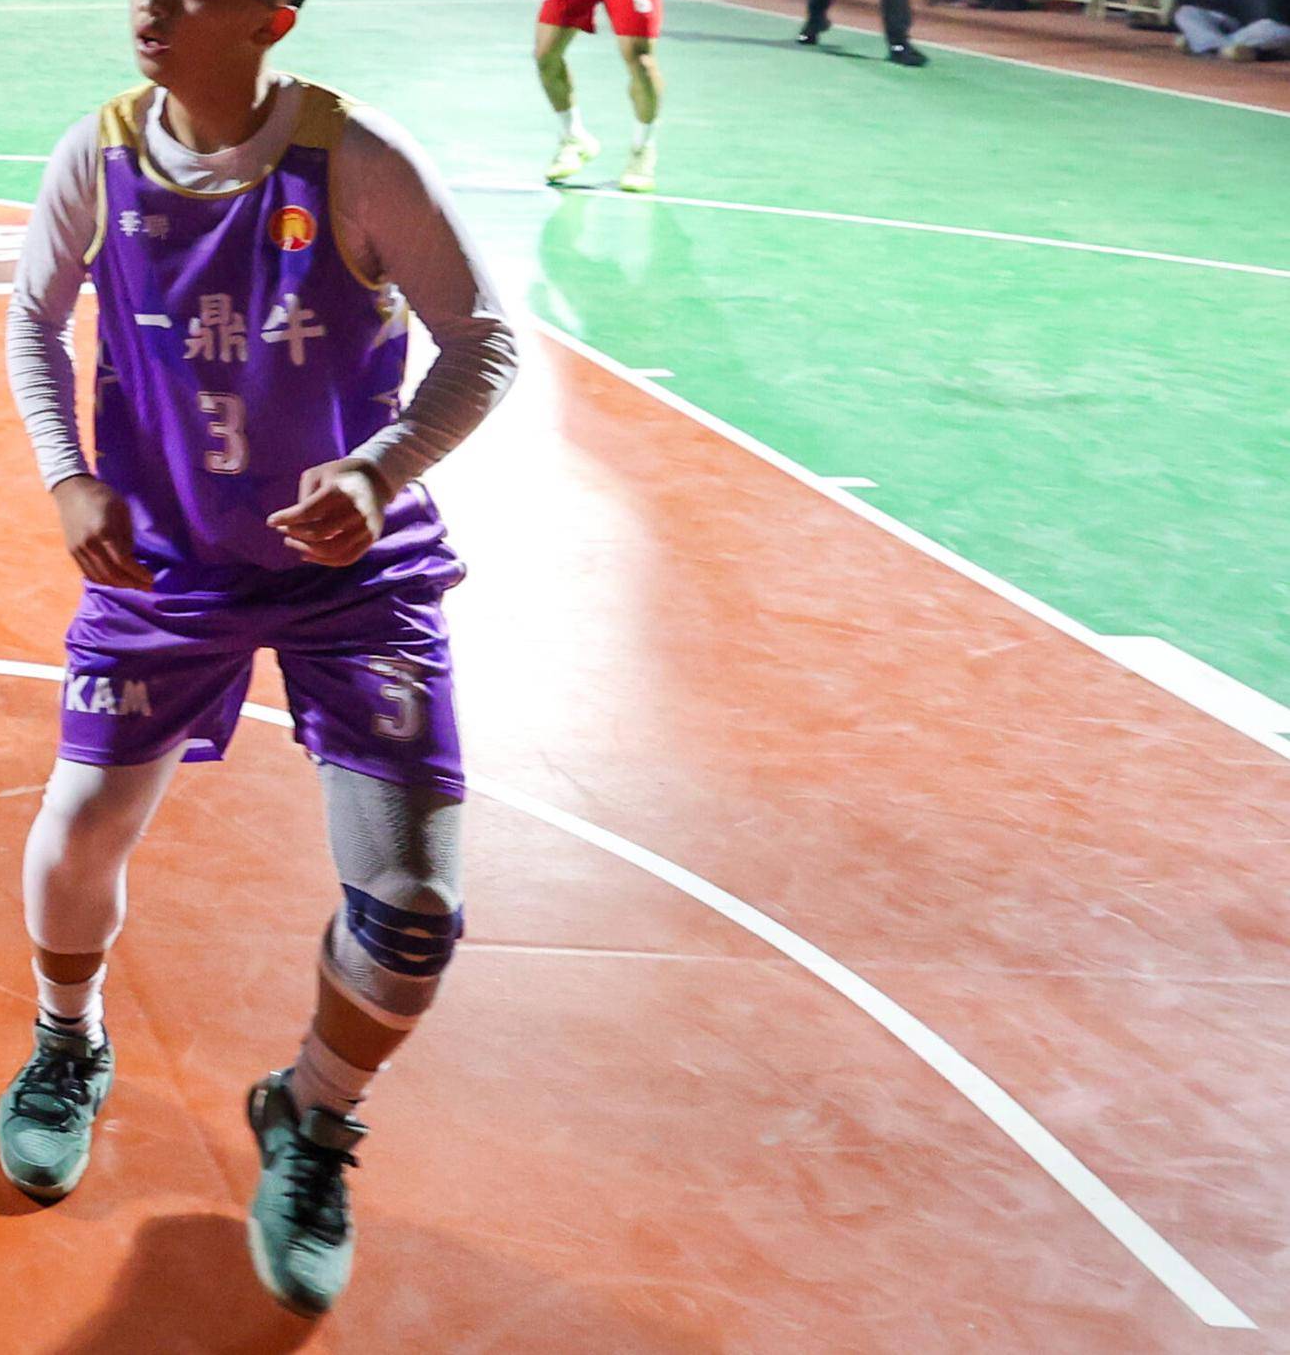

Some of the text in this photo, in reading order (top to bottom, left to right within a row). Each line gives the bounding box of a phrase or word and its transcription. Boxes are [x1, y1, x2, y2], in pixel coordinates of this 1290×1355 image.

[133, 293, 327, 366] 一鼎牛
[196, 391, 249, 475] 3
[65, 674, 155, 717] KAM
